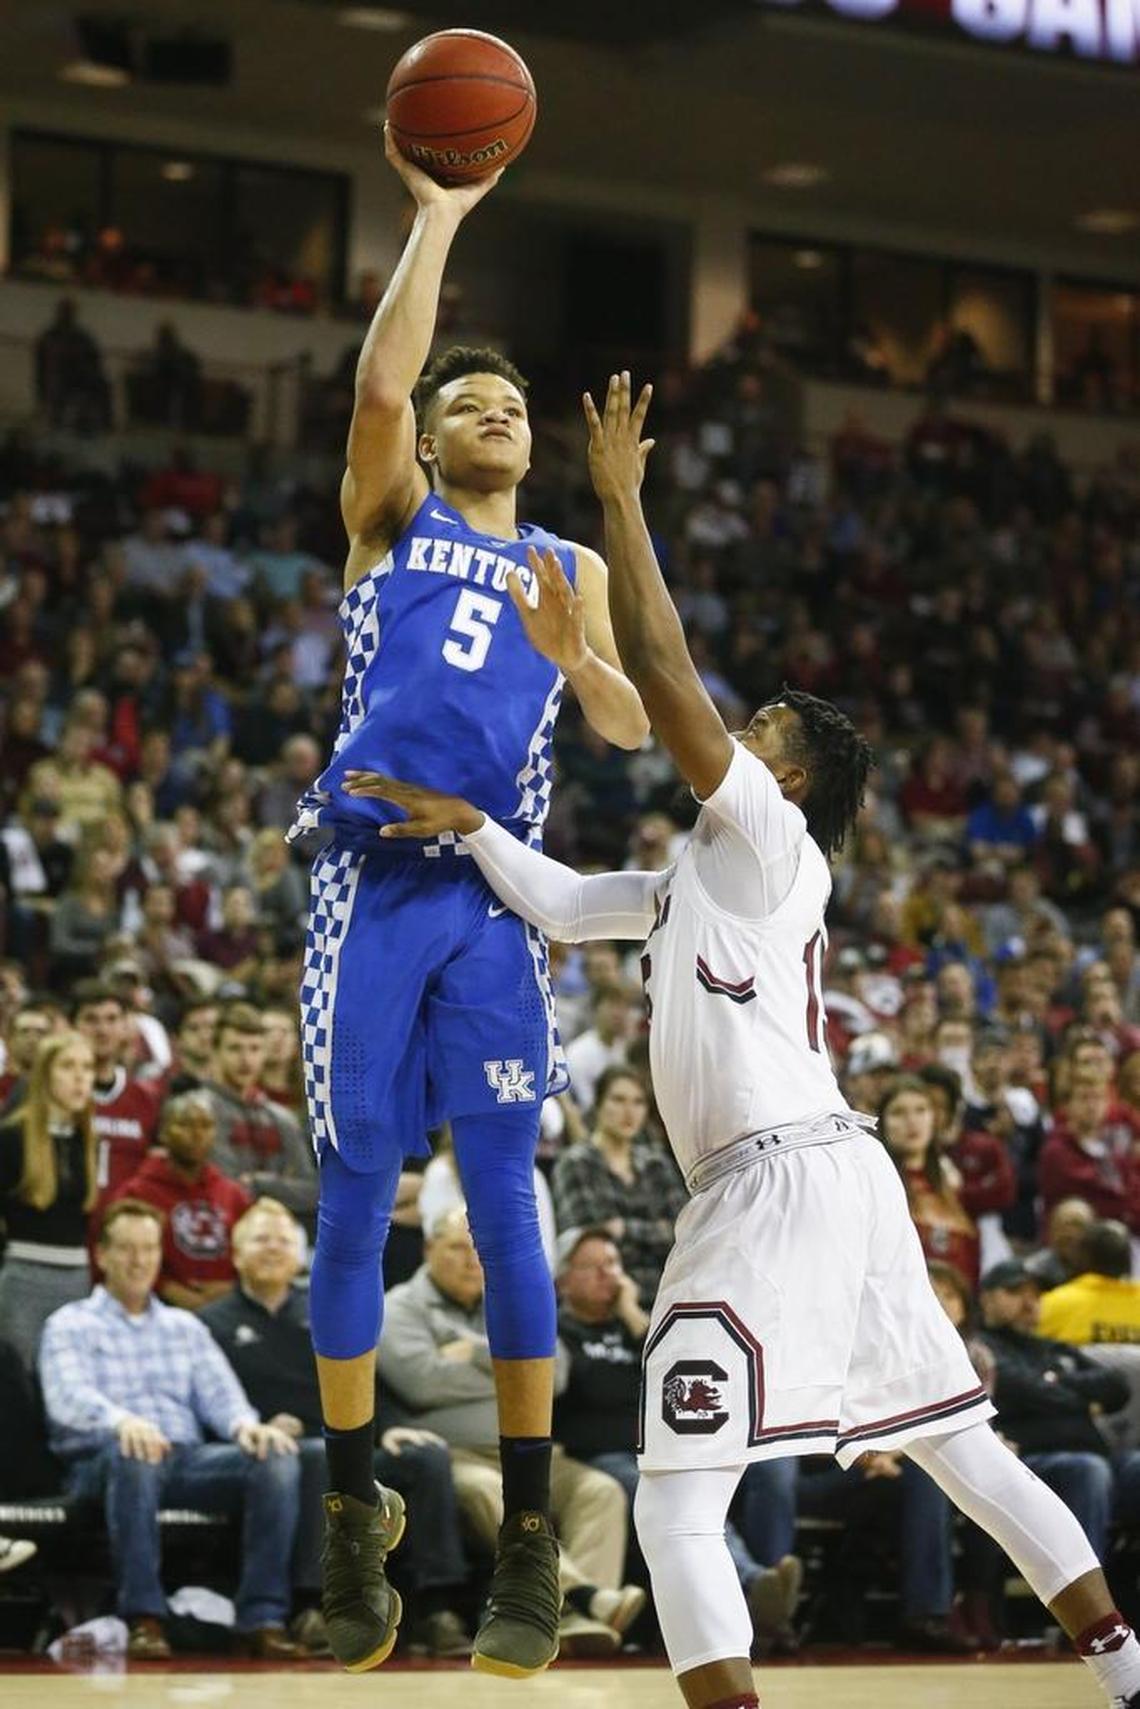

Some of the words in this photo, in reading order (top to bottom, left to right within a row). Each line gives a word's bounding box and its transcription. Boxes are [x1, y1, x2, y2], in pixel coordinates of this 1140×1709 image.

[406, 537, 541, 610] KENTUC
[441, 587, 503, 672] 5
[483, 1059, 537, 1104] UK
